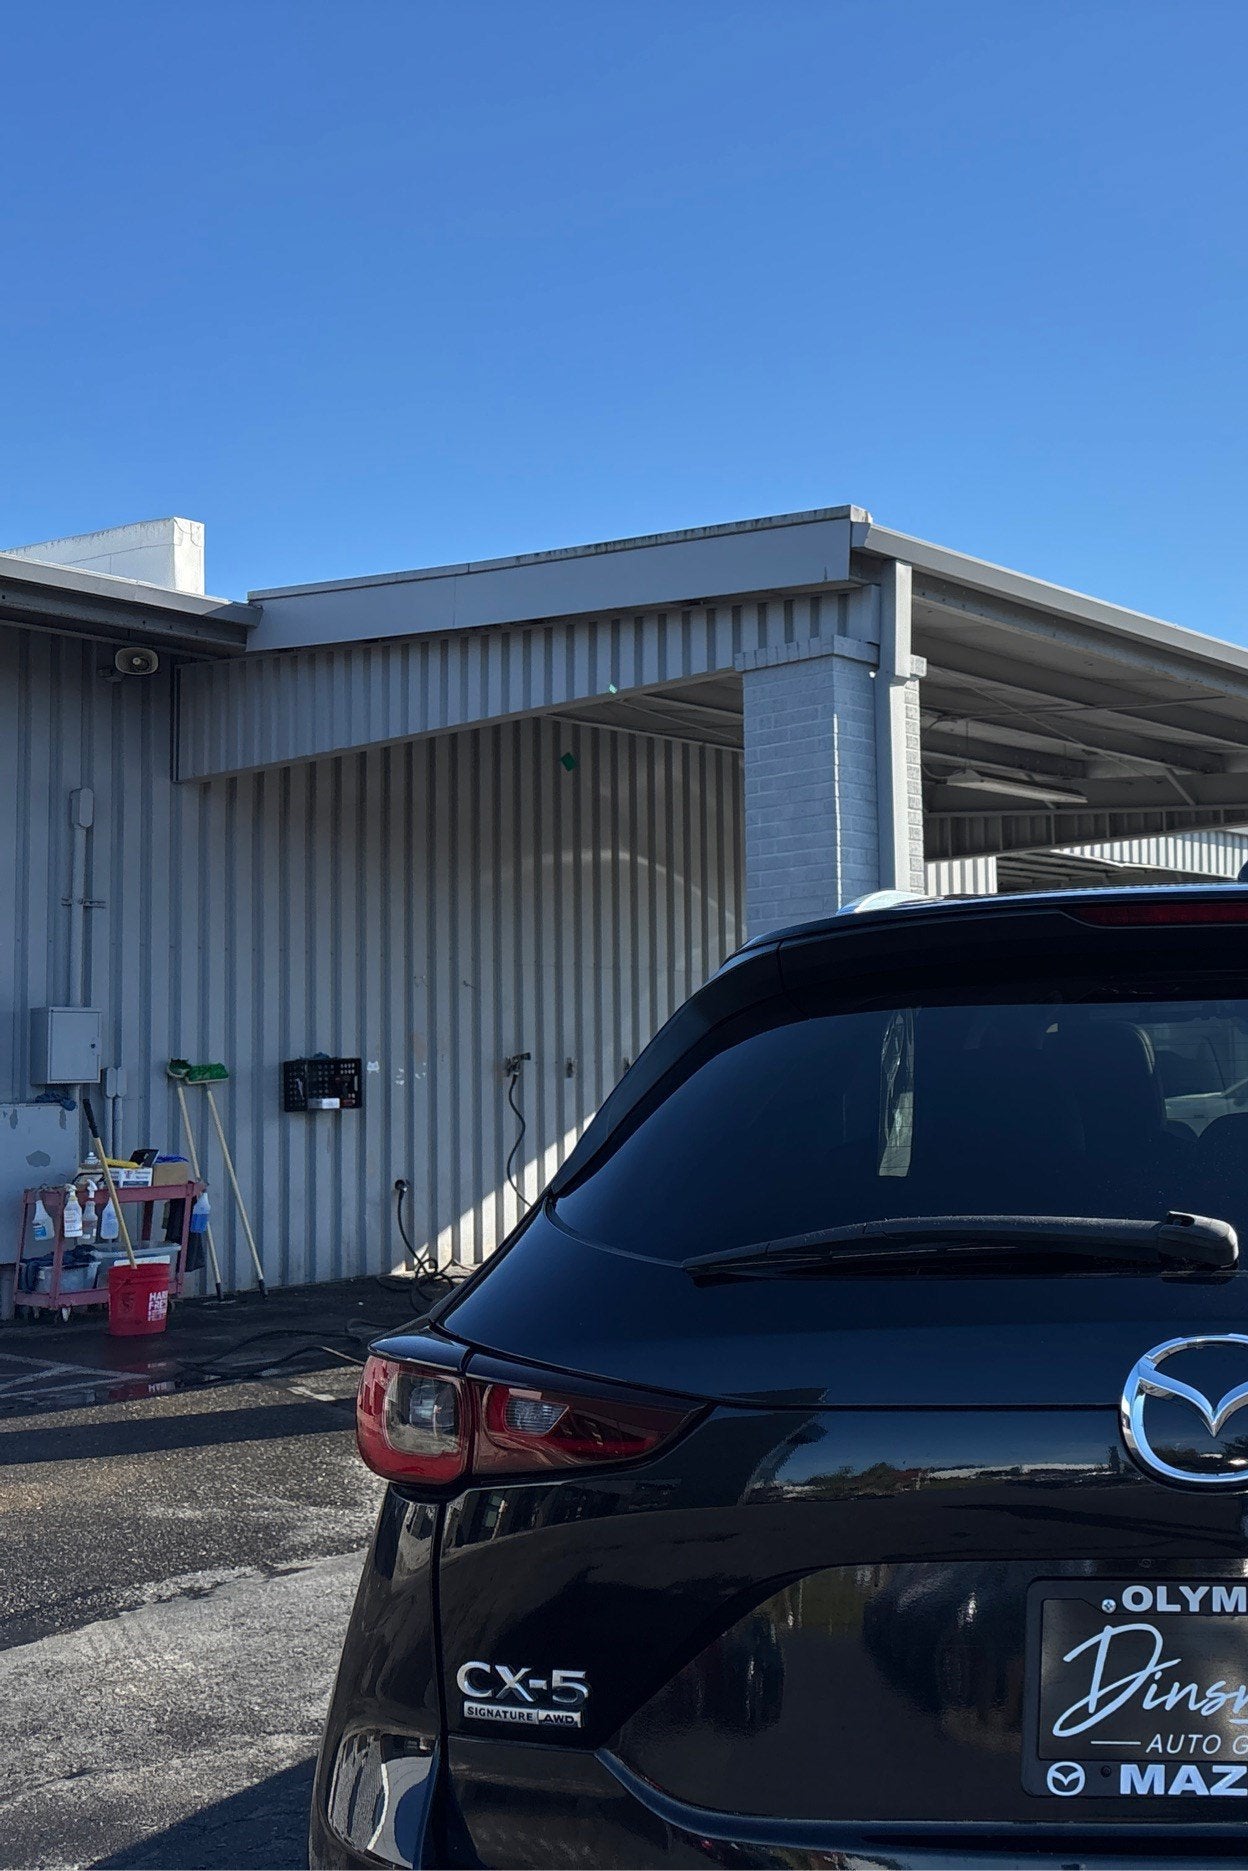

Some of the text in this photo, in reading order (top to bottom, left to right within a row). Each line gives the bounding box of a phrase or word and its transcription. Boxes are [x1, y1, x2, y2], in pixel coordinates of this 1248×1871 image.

[456, 1661, 589, 1703] CX-5
[467, 1706, 533, 1722] SIGNATURE
[542, 1713, 575, 1724] AWD
[1145, 1733, 1221, 1754] AUTO
